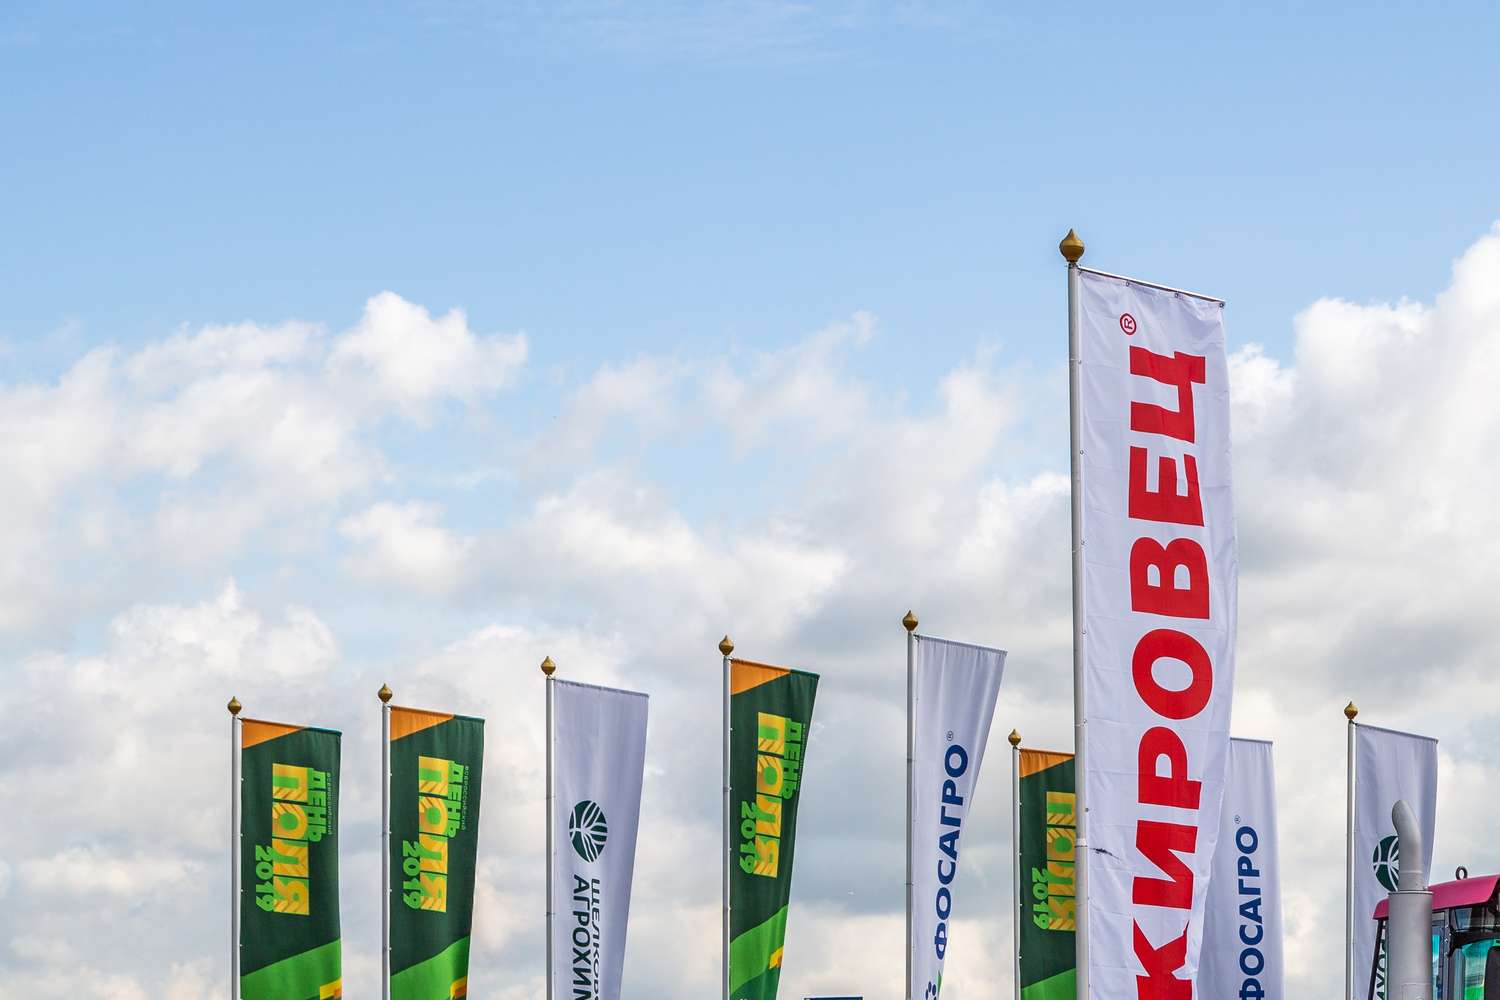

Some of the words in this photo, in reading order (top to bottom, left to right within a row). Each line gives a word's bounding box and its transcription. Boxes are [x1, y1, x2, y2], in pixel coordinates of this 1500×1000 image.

[753, 711, 786, 878] ПОЛЯ
[782, 718, 802, 800] ДЕНЬ
[307, 768, 326, 842] ДЕНЬ
[418, 755, 449, 913] ПОЛЯ
[447, 760, 464, 838] ДЕНЬ
[739, 801, 757, 874] 2019
[255, 844, 273, 912] 2019
[272, 763, 310, 915] ПОЛЯ
[402, 840, 422, 909] 2019
[934, 744, 969, 960] ФОСАГРО
[1032, 867, 1049, 930] 2019
